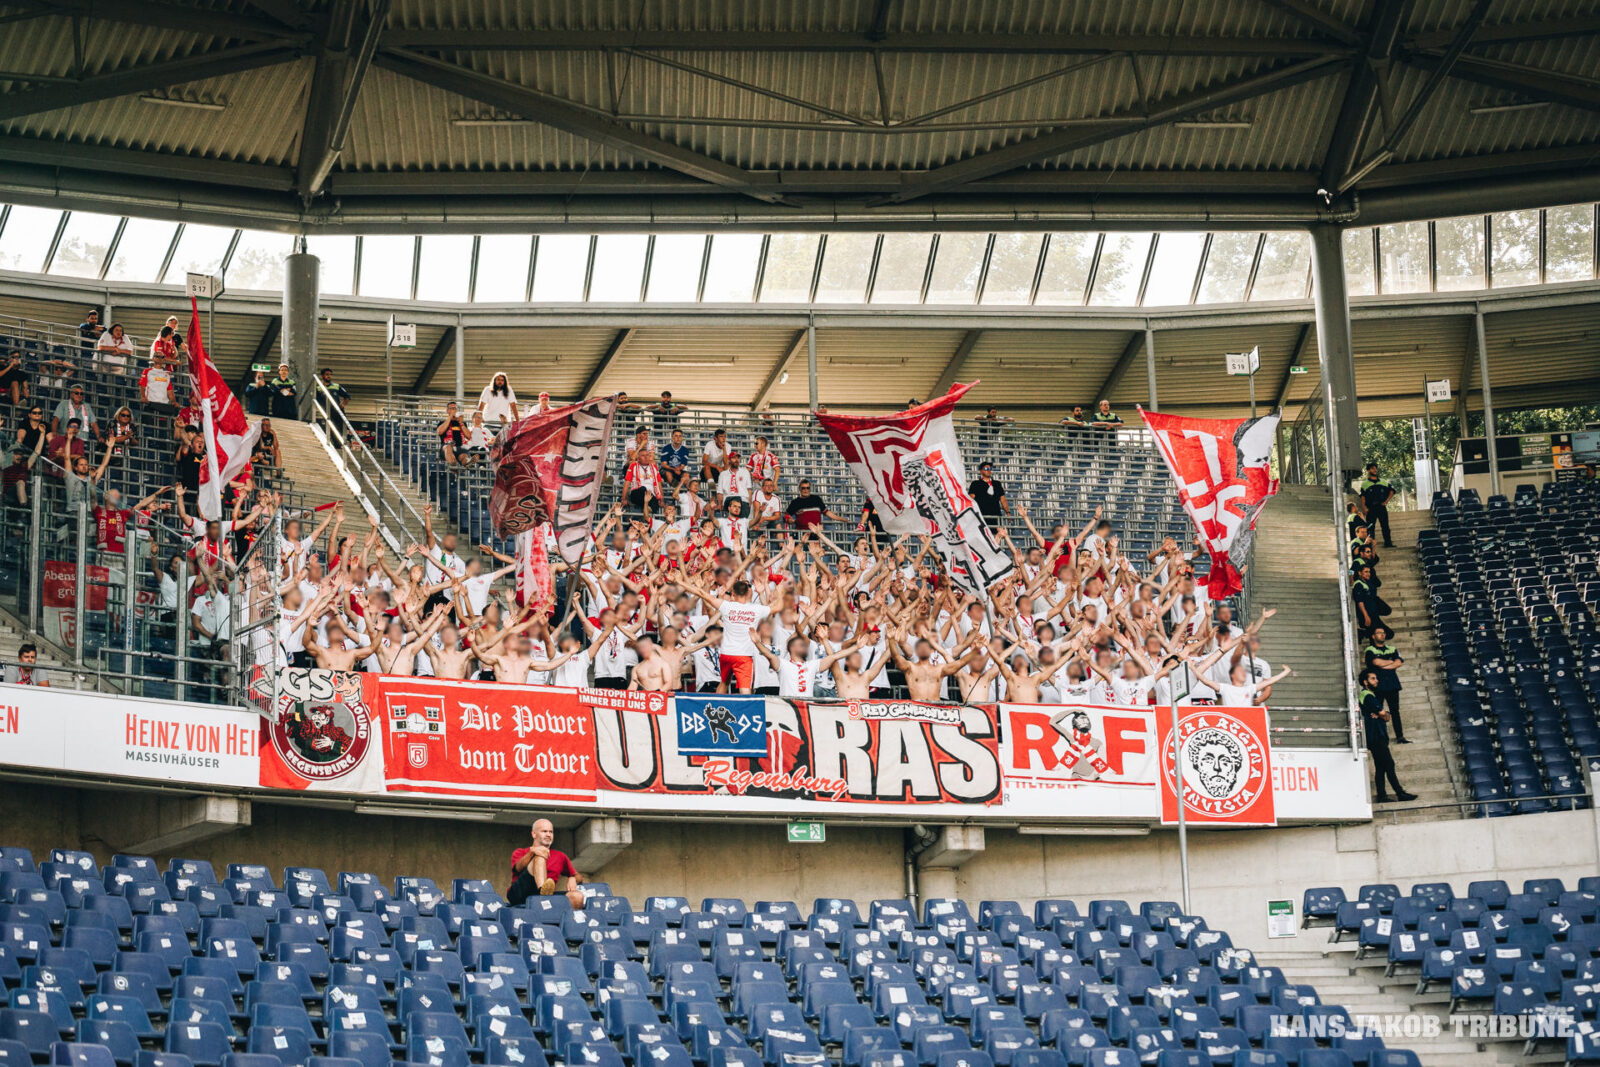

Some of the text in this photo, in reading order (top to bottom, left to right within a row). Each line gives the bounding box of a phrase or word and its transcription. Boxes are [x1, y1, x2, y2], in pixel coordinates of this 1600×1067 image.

[578, 687, 646, 700] CHRISTOPH FÜR
[579, 694, 646, 710] IMMER BEI UNS
[457, 701, 587, 738] Die Power
[681, 711, 763, 735] BB 95
[861, 703, 961, 722] RED GENERATION
[226, 723, 261, 758] HEI
[1009, 711, 1147, 775] R F
[125, 750, 220, 768] MASSIVHÄUSER
[285, 749, 356, 776] REGENSBURG
[459, 743, 590, 775] vom Tower
[703, 760, 849, 800] Regensburg
